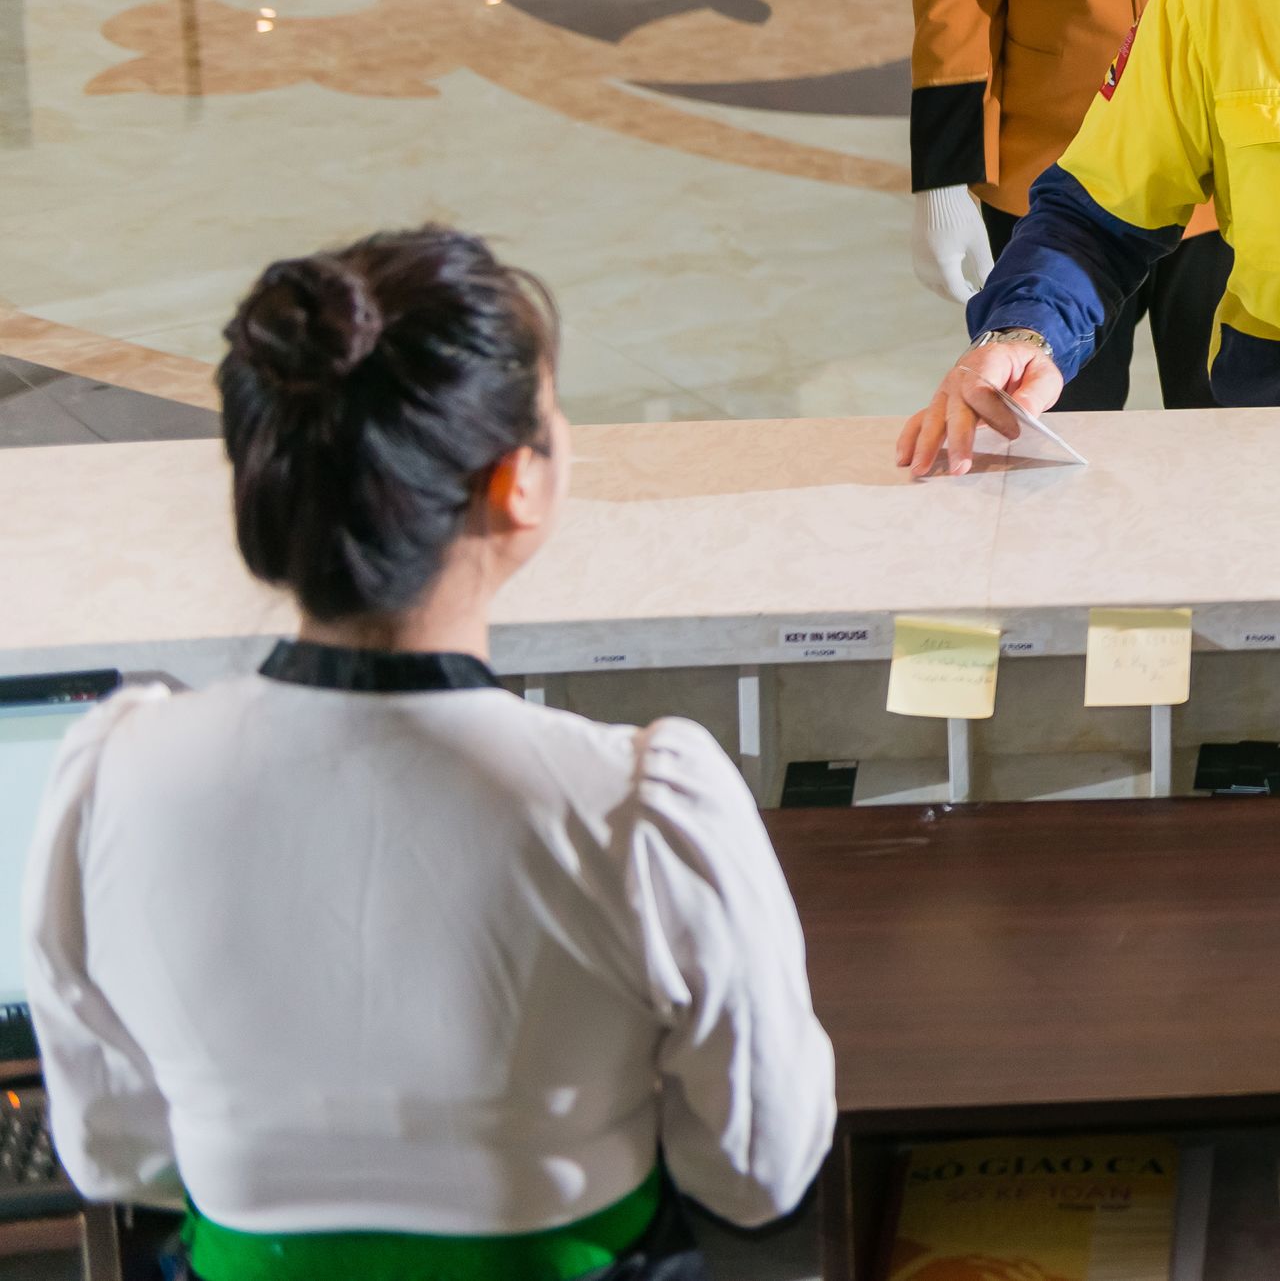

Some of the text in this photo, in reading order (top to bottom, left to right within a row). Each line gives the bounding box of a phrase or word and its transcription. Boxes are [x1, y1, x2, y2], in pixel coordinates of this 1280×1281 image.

[784, 632, 807, 643] KEY
[826, 629, 868, 641] HOUSE
[977, 1155, 1094, 1177] GIAO
[1105, 1155, 1165, 1176] CA
